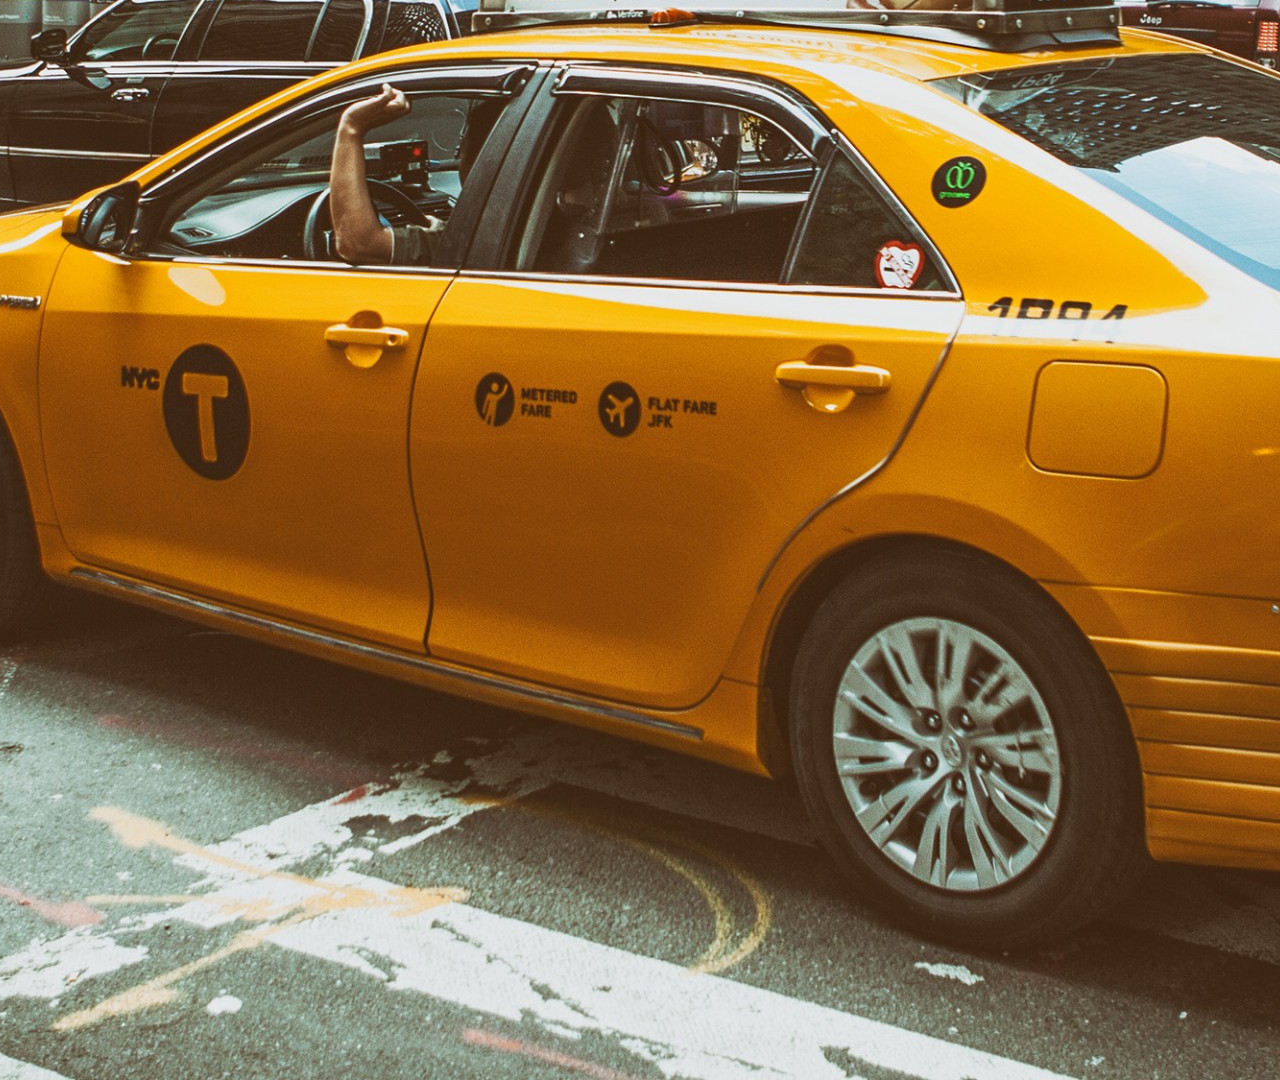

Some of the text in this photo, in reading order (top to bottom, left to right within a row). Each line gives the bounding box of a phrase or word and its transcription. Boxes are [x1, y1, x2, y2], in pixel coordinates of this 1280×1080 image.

[1139, 13, 1162, 25] Jeep
[520, 387, 578, 404] METERED
[121, 365, 229, 462] NYC T
[520, 403, 552, 418] FARE
[648, 396, 718, 416] FLAT FARE
[647, 414, 674, 428] JFK
